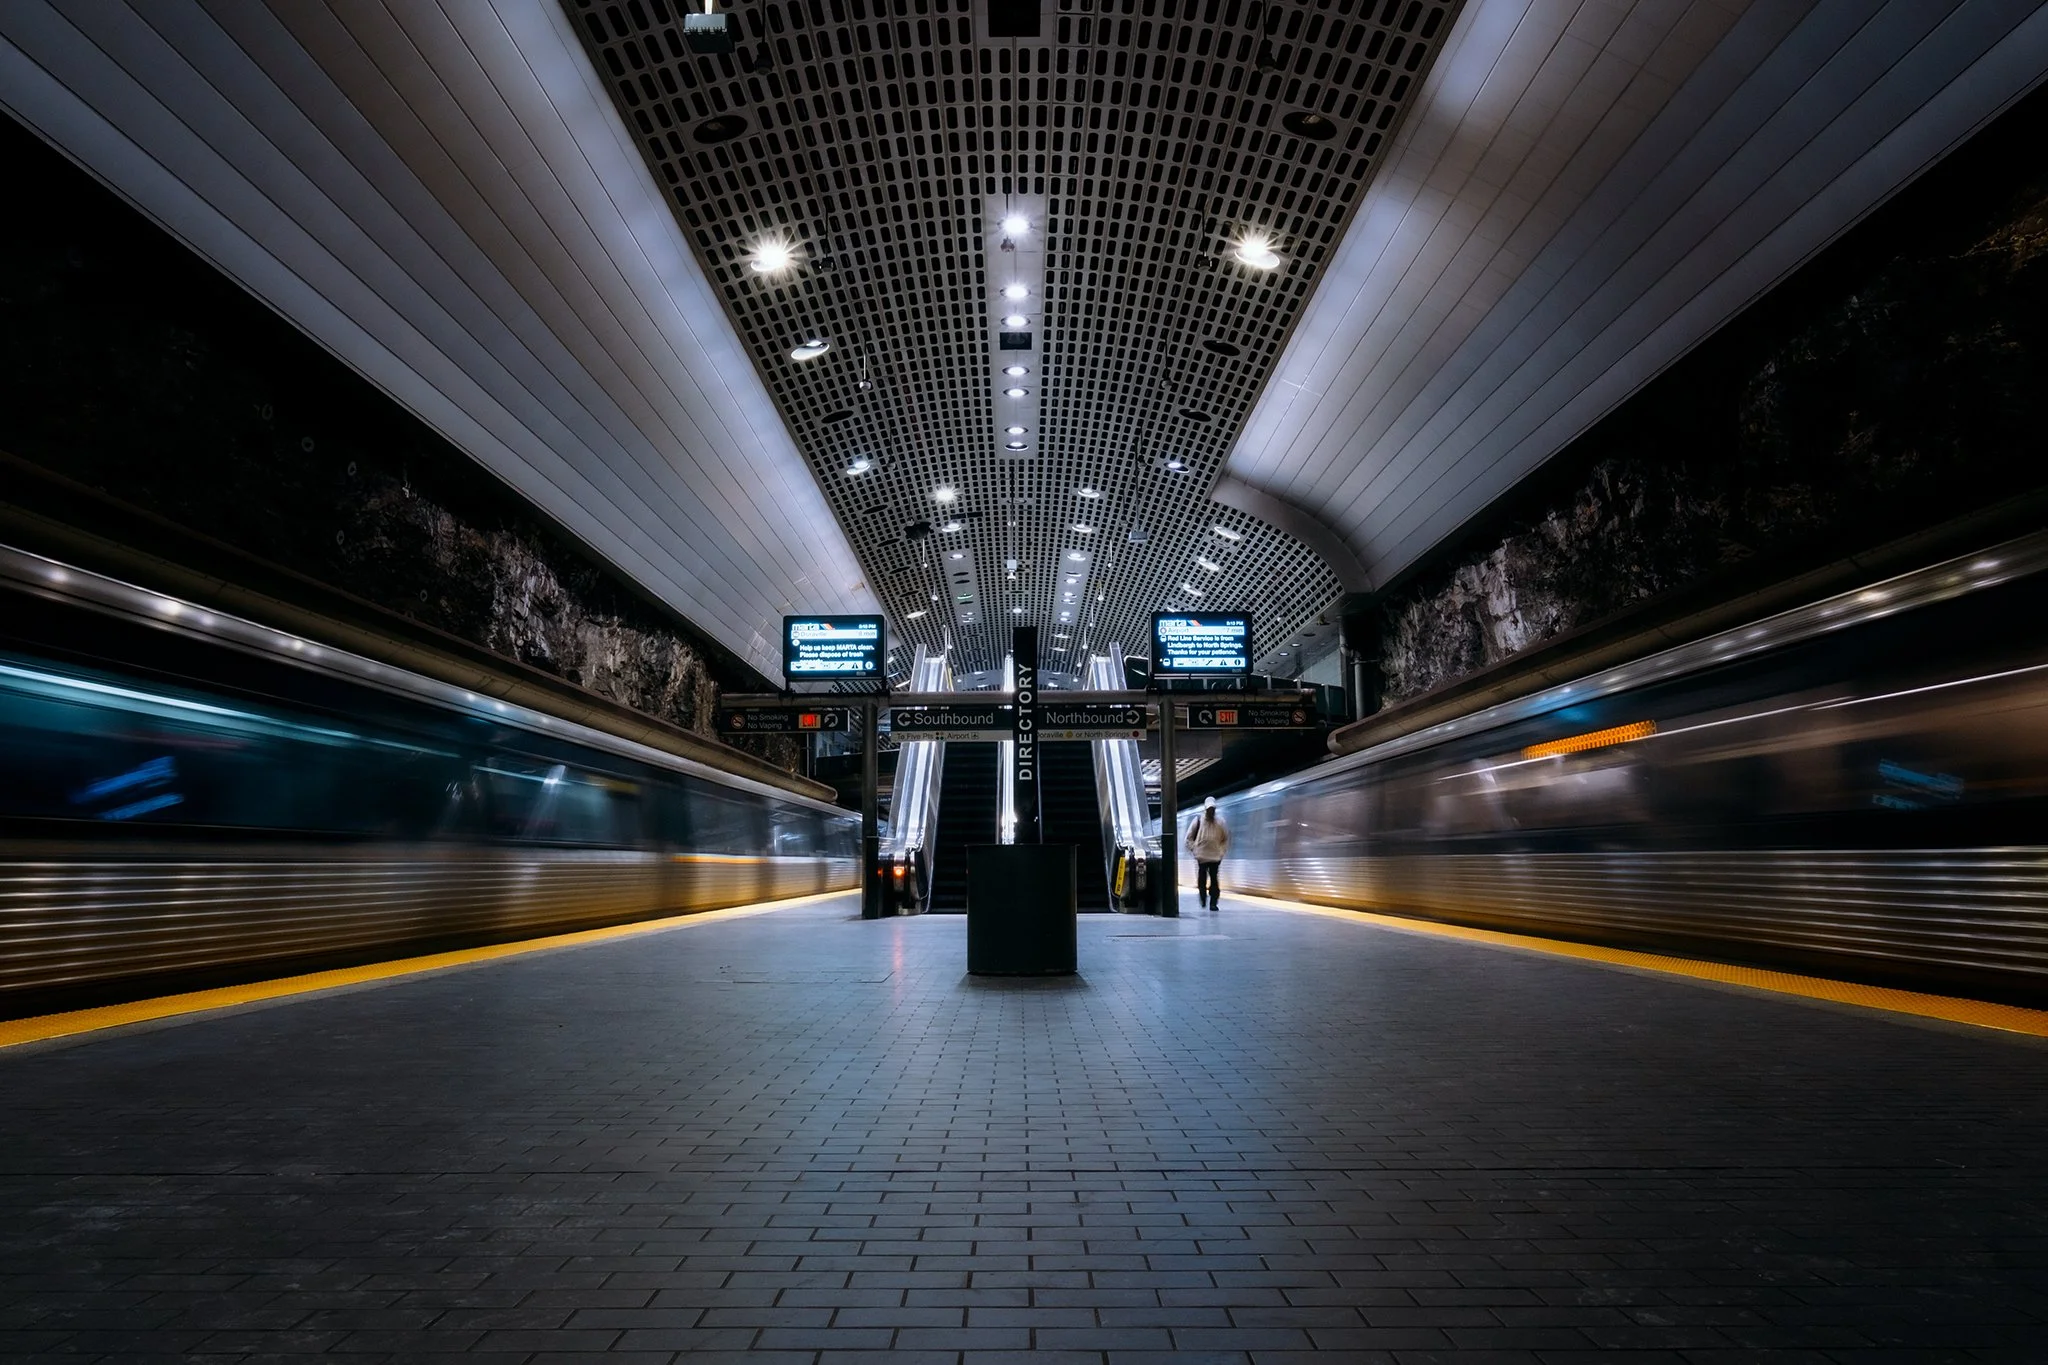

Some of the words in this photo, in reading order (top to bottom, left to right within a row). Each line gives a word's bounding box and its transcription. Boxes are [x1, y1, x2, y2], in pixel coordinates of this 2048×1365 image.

[914, 712, 994, 725] Southbound
[1018, 664, 1032, 780] DIRECTORY
[1046, 712, 1124, 724] Northbound
[1220, 712, 1234, 722] EXIT
[1105, 731, 1130, 739] Springs
